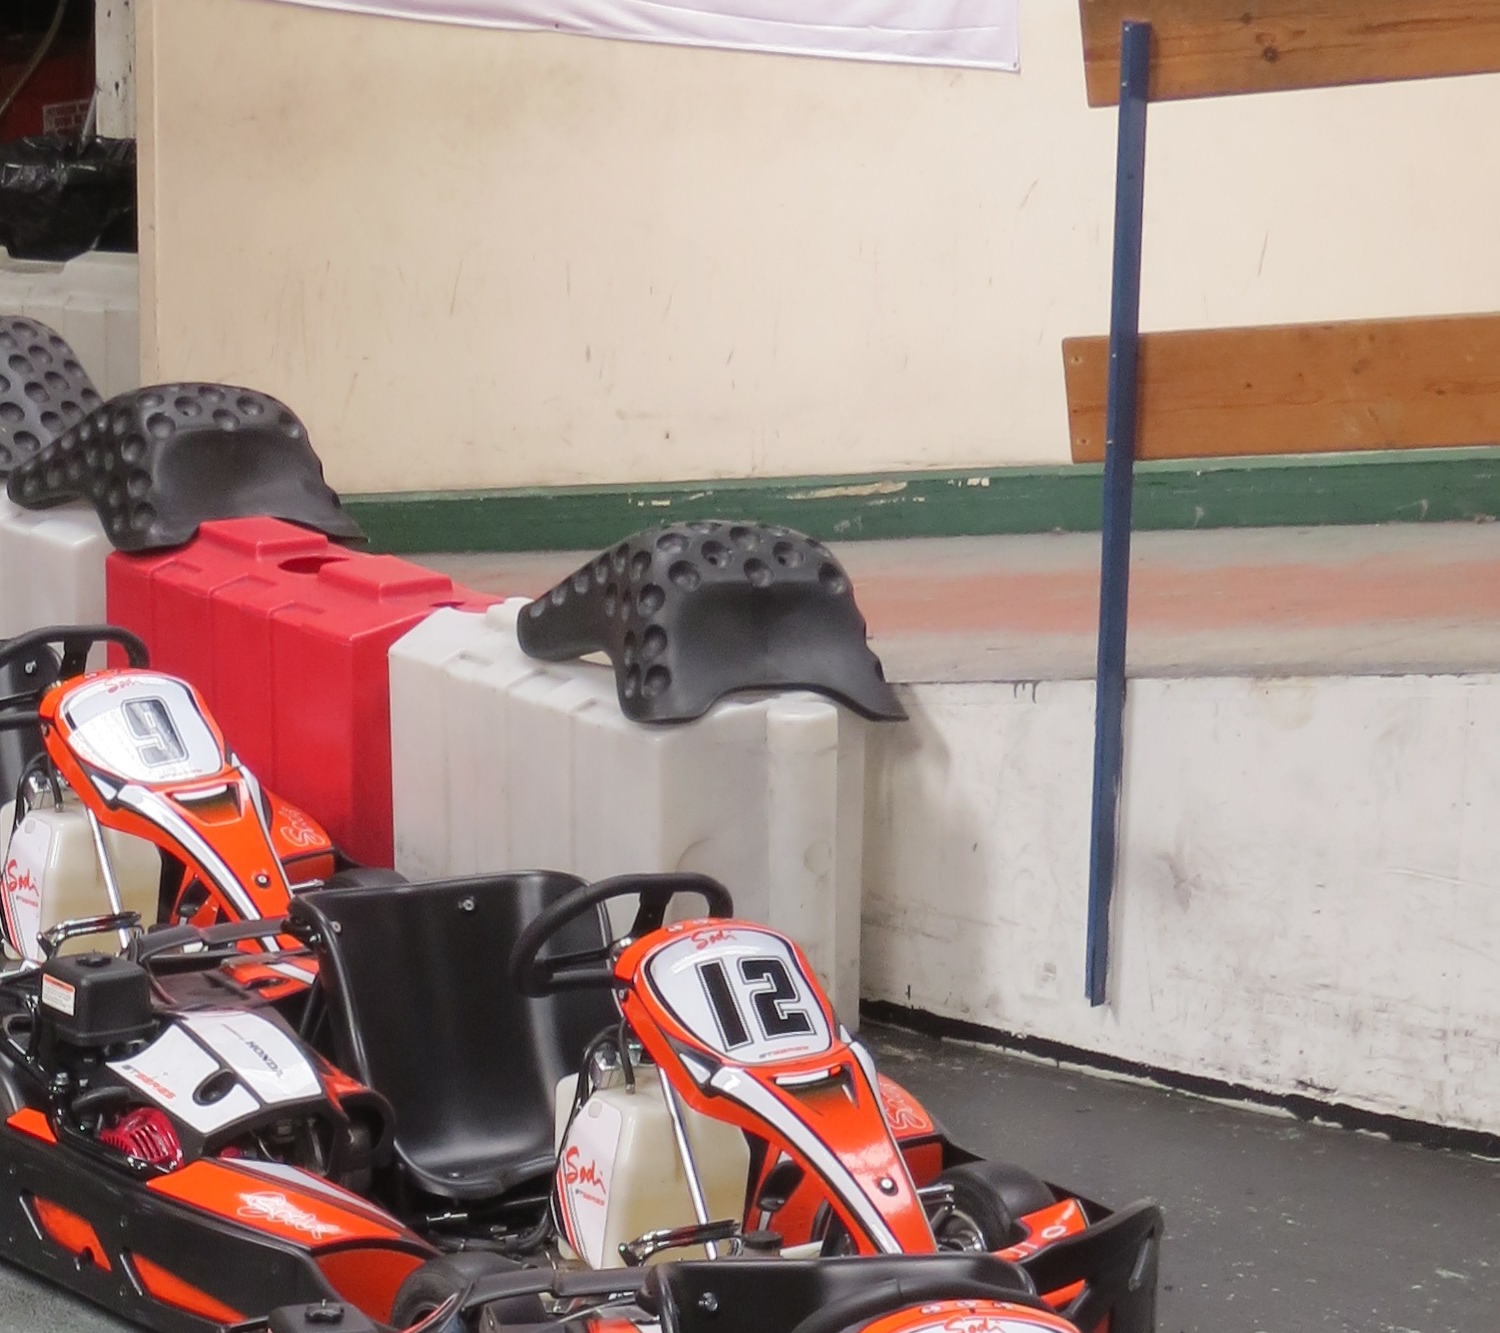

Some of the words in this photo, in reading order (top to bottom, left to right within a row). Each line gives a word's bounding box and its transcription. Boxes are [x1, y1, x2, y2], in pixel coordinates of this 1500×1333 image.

[121, 695, 190, 768] 9
[7, 859, 40, 898] Sodi
[691, 930, 739, 950] Sodi
[695, 956, 818, 1053] 12
[565, 1145, 608, 1195] Sodi
